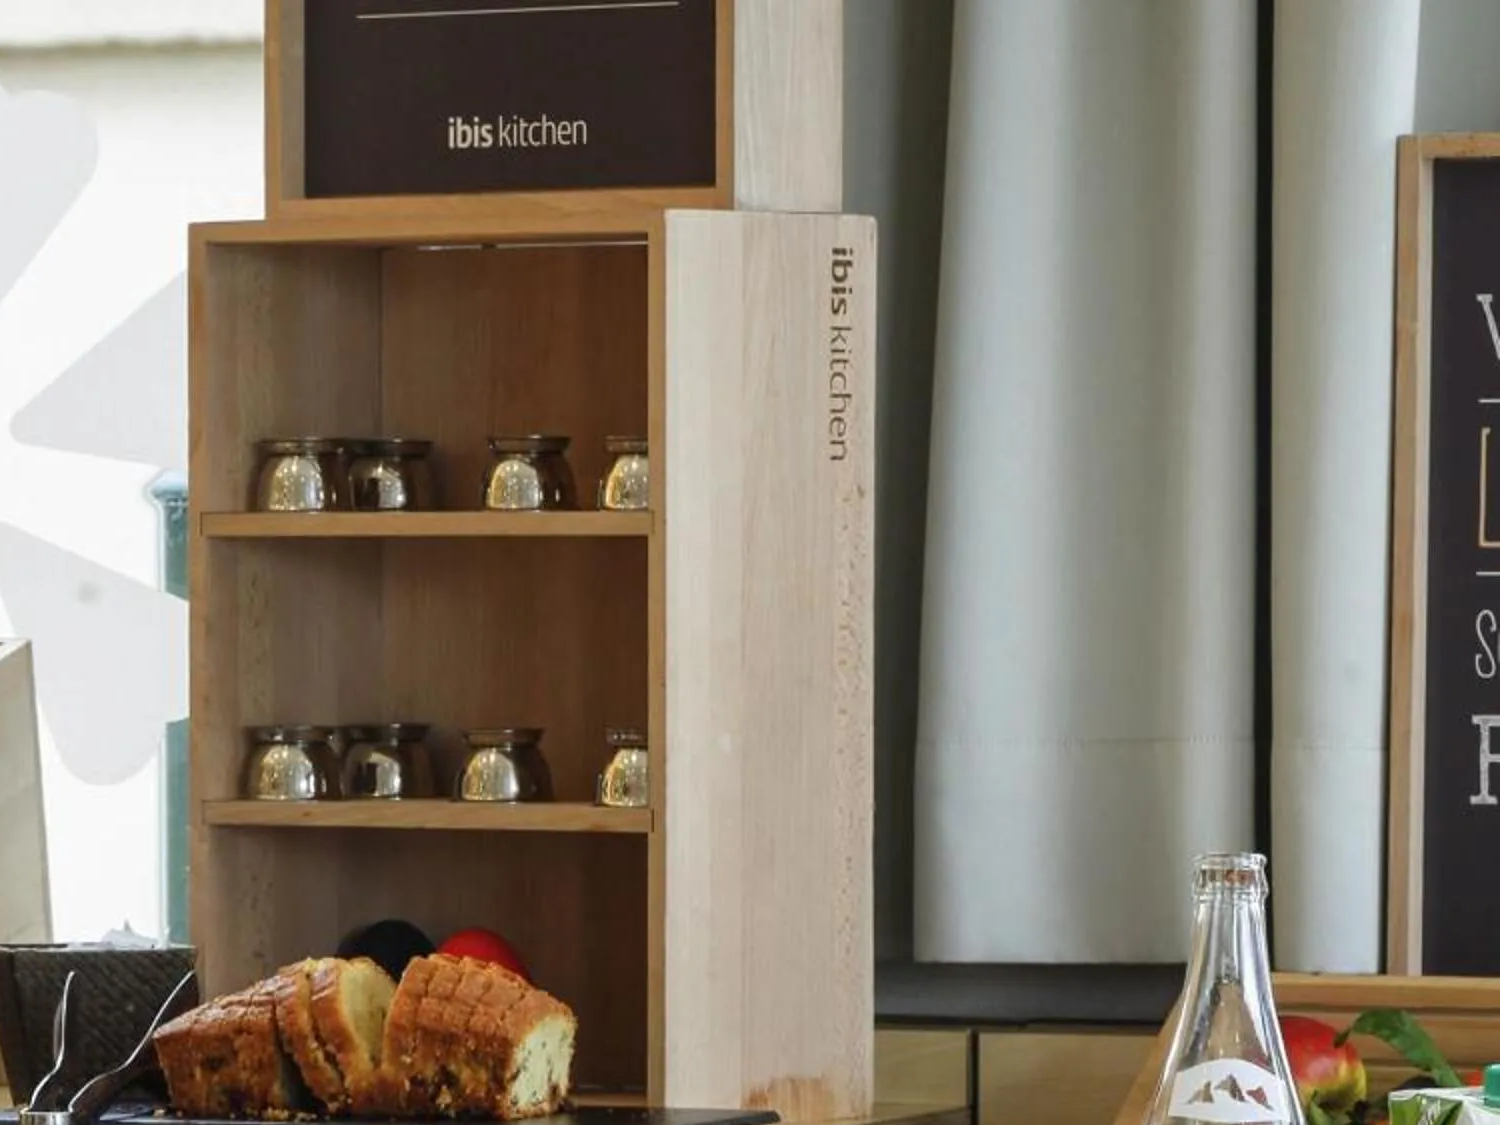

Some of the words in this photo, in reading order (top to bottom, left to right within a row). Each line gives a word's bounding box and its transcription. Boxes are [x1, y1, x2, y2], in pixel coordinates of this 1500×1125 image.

[448, 116, 494, 149] ibis
[498, 113, 588, 148] kitchen
[831, 247, 853, 316] ibis
[829, 325, 853, 462] kitchen
